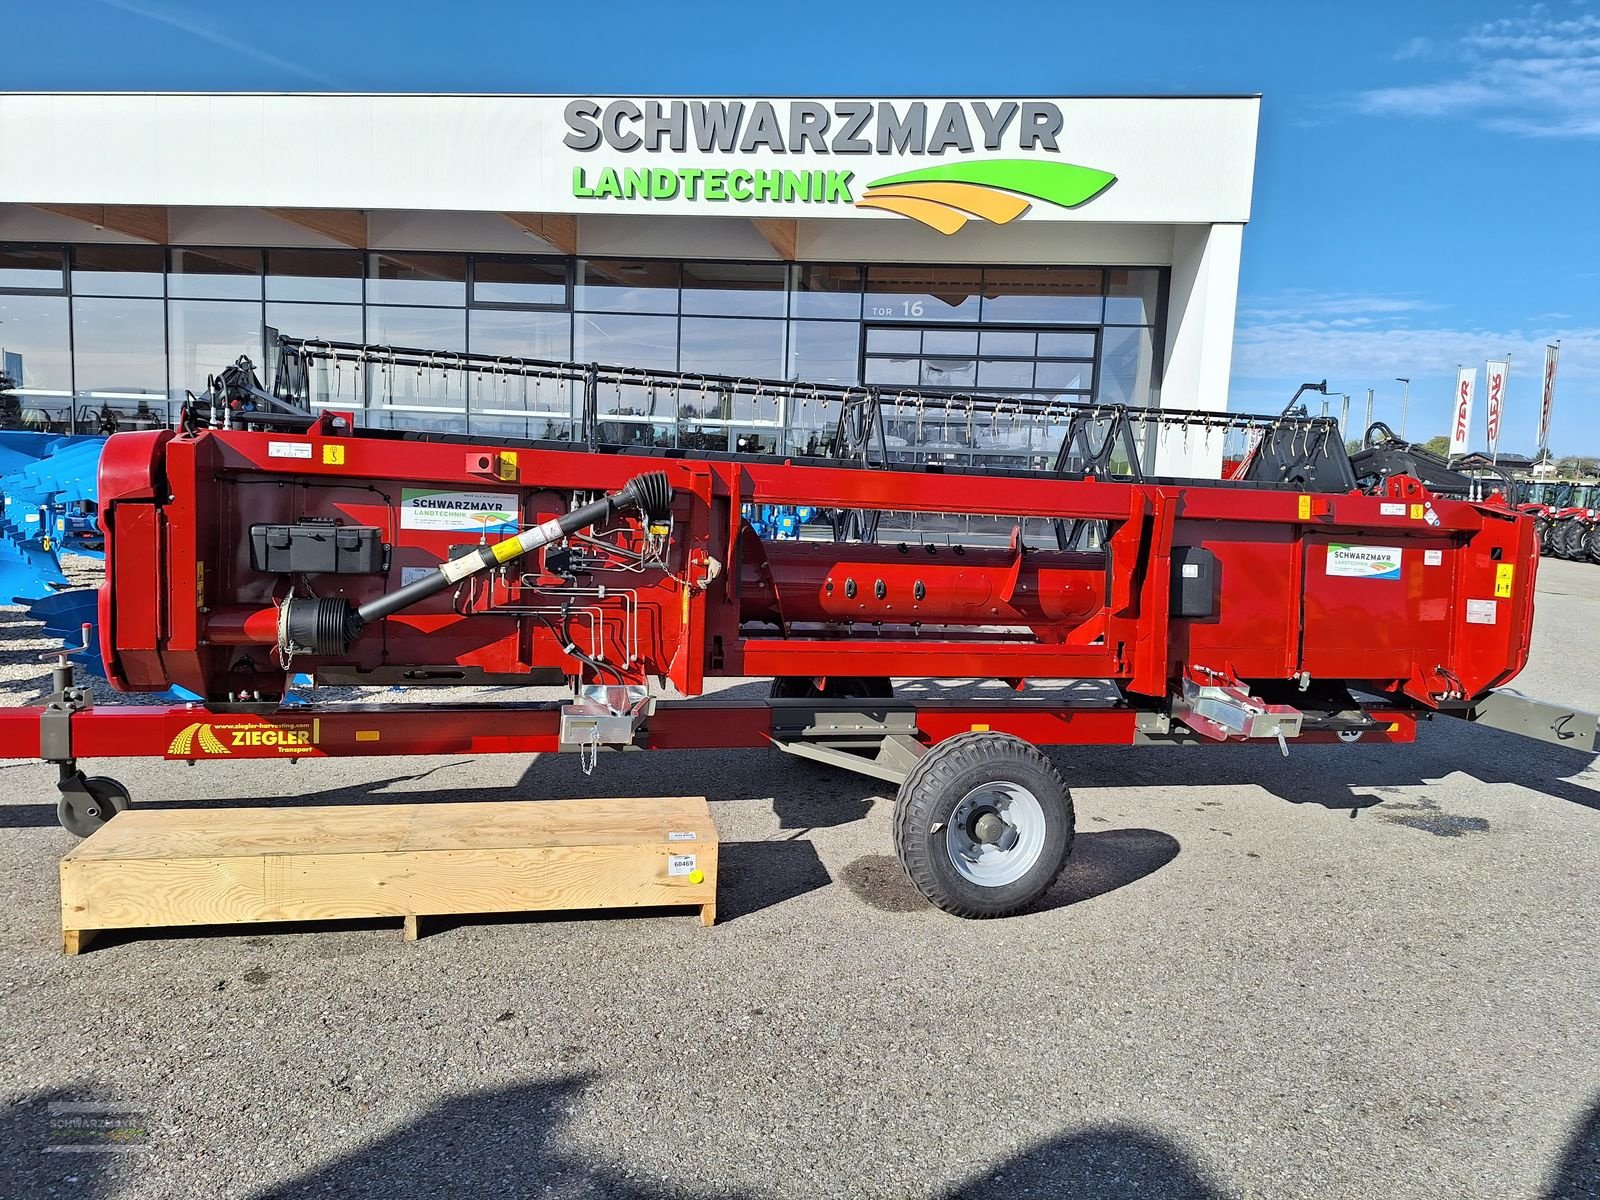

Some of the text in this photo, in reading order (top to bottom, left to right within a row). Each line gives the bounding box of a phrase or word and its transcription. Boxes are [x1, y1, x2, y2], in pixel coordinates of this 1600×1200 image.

[562, 99, 1064, 155] SCHWARZMAYR
[572, 166, 855, 203] LANDTECHNIK
[872, 300, 924, 317] TOR 16
[1455, 380, 1470, 443] STEYR
[412, 498, 503, 512] SCHWARZMAYR
[414, 509, 467, 518] LANDTECHNIK
[1334, 551, 1391, 562] SCHWARZMAYR
[214, 722, 310, 731] www.ziegler-harvesting.com
[231, 731, 310, 746] ZIEGLER
[277, 746, 313, 754] Transport
[674, 860, 694, 868] 60469
